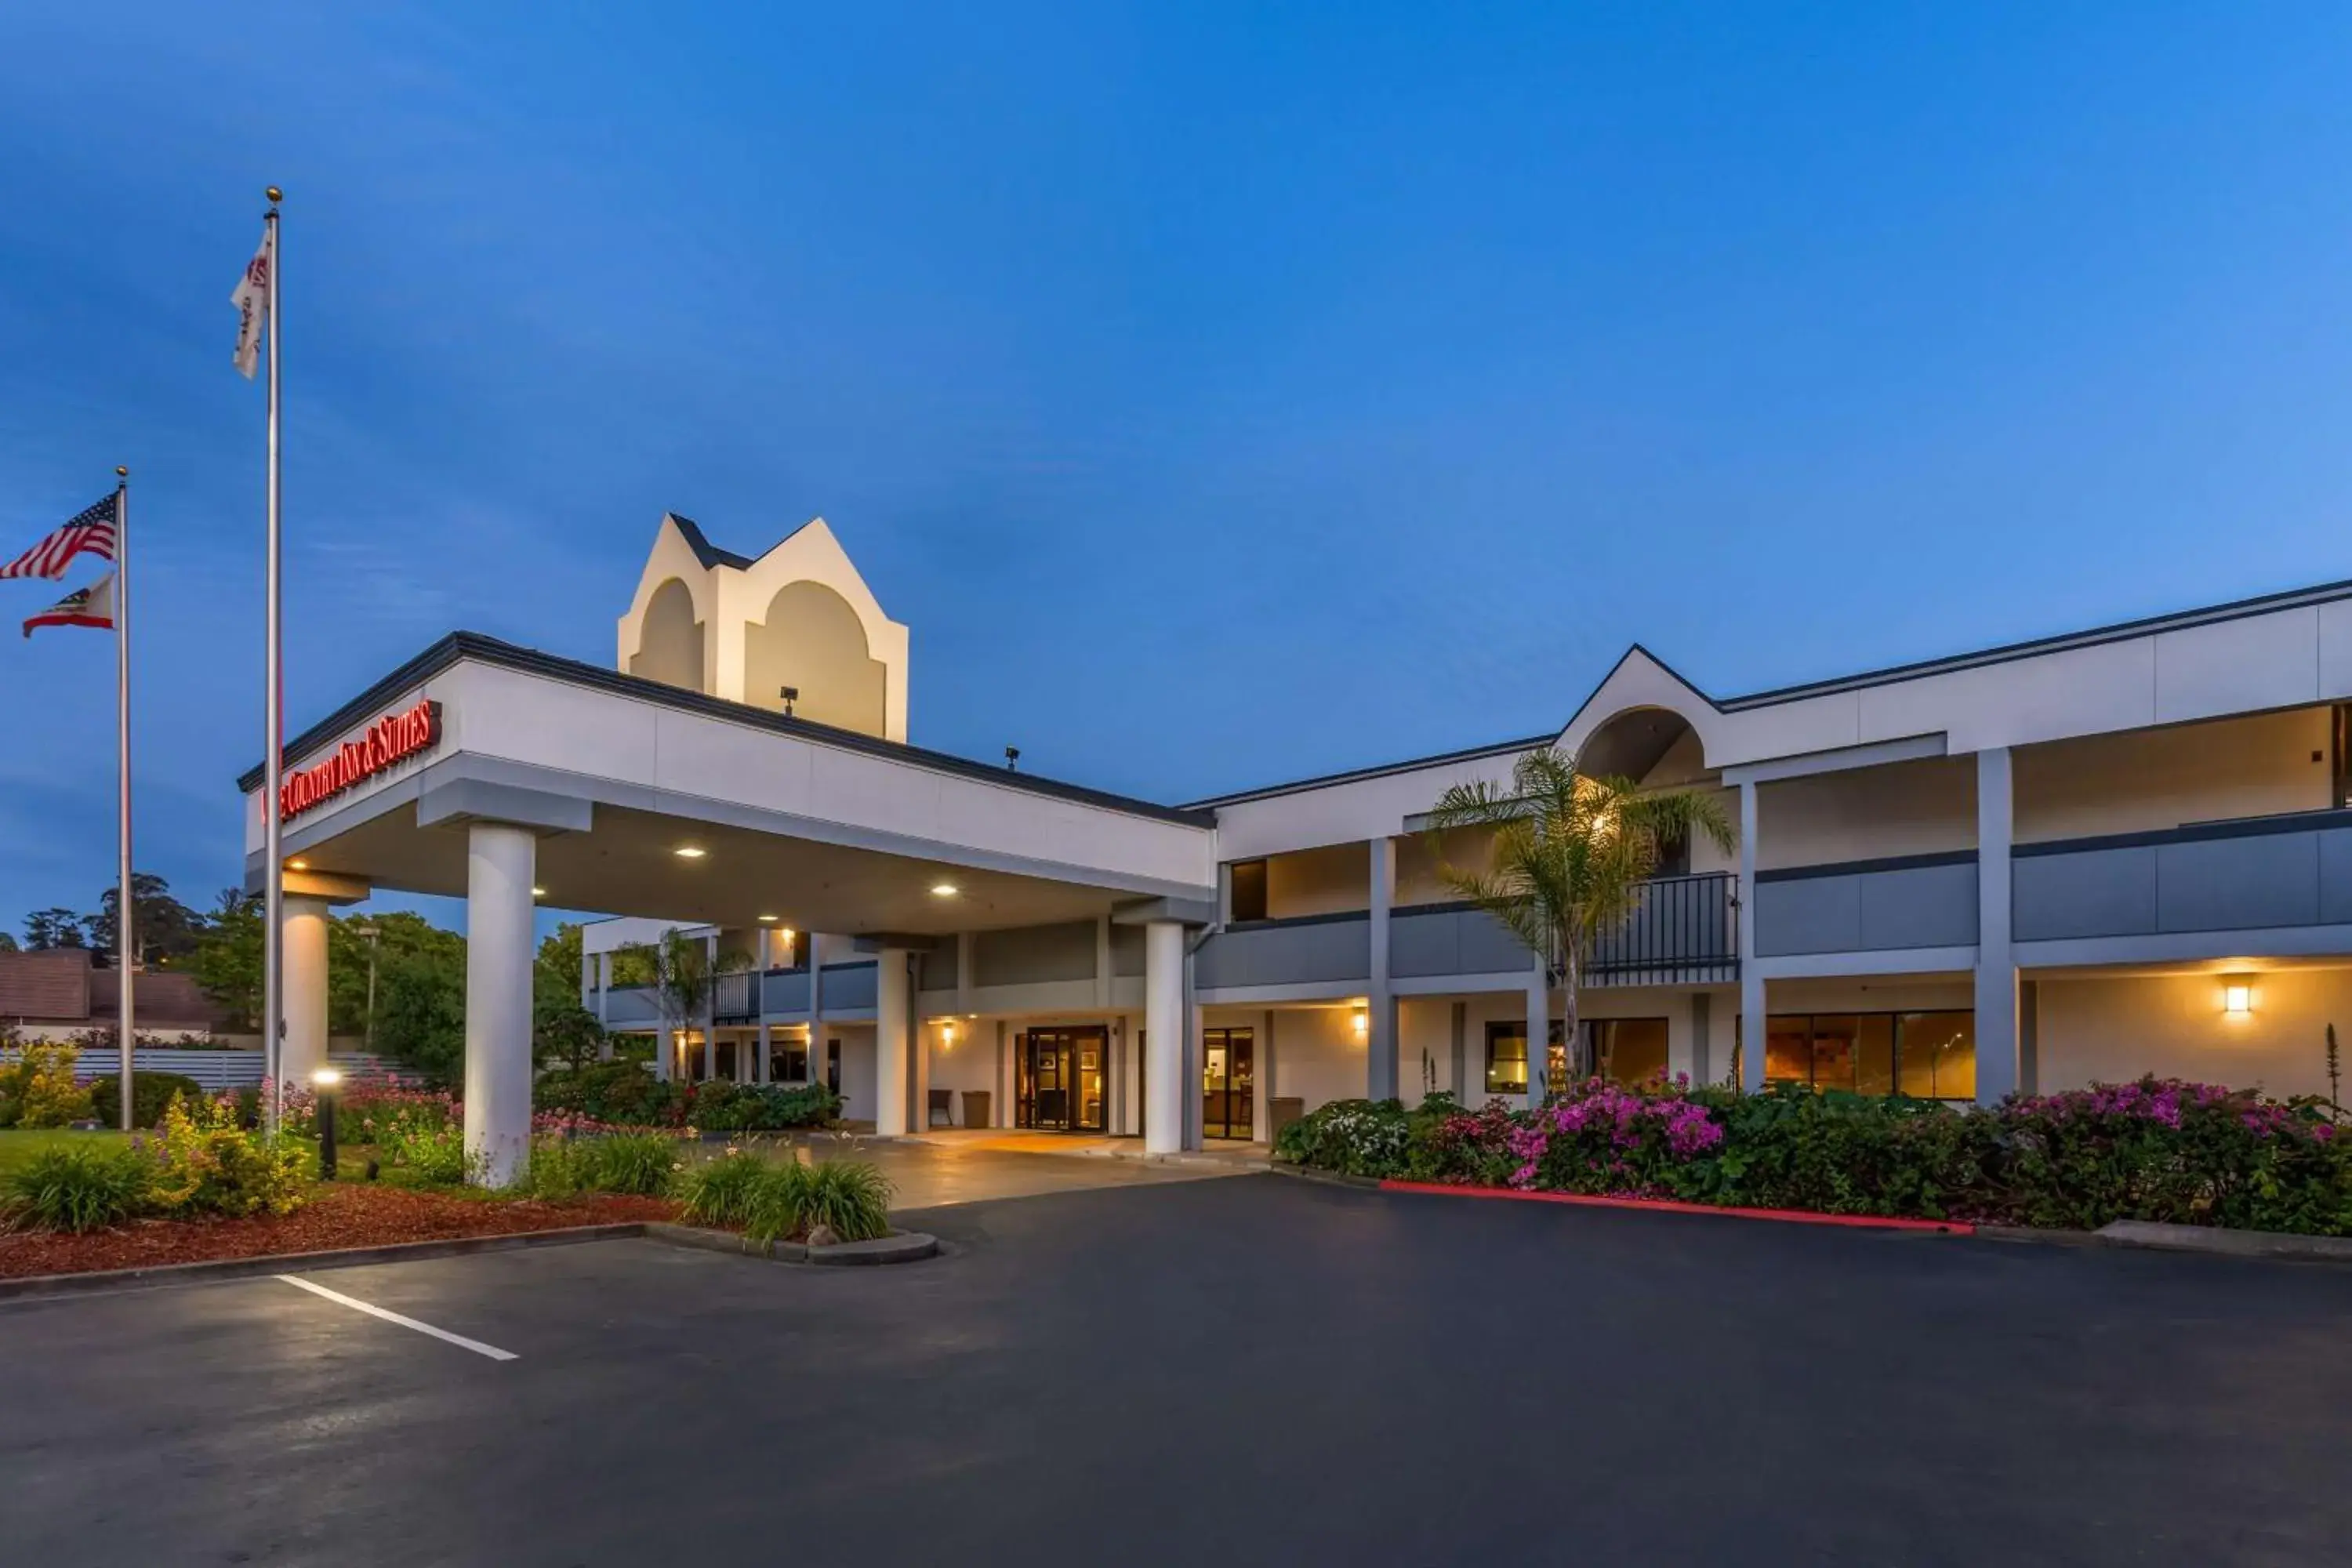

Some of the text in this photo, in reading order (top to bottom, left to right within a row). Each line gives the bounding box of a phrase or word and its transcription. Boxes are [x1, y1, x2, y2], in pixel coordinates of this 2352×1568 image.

[288, 756, 336, 813] COUNTRY
[339, 742, 361, 786] INN
[364, 726, 376, 774] &
[378, 700, 430, 764] SUITES
